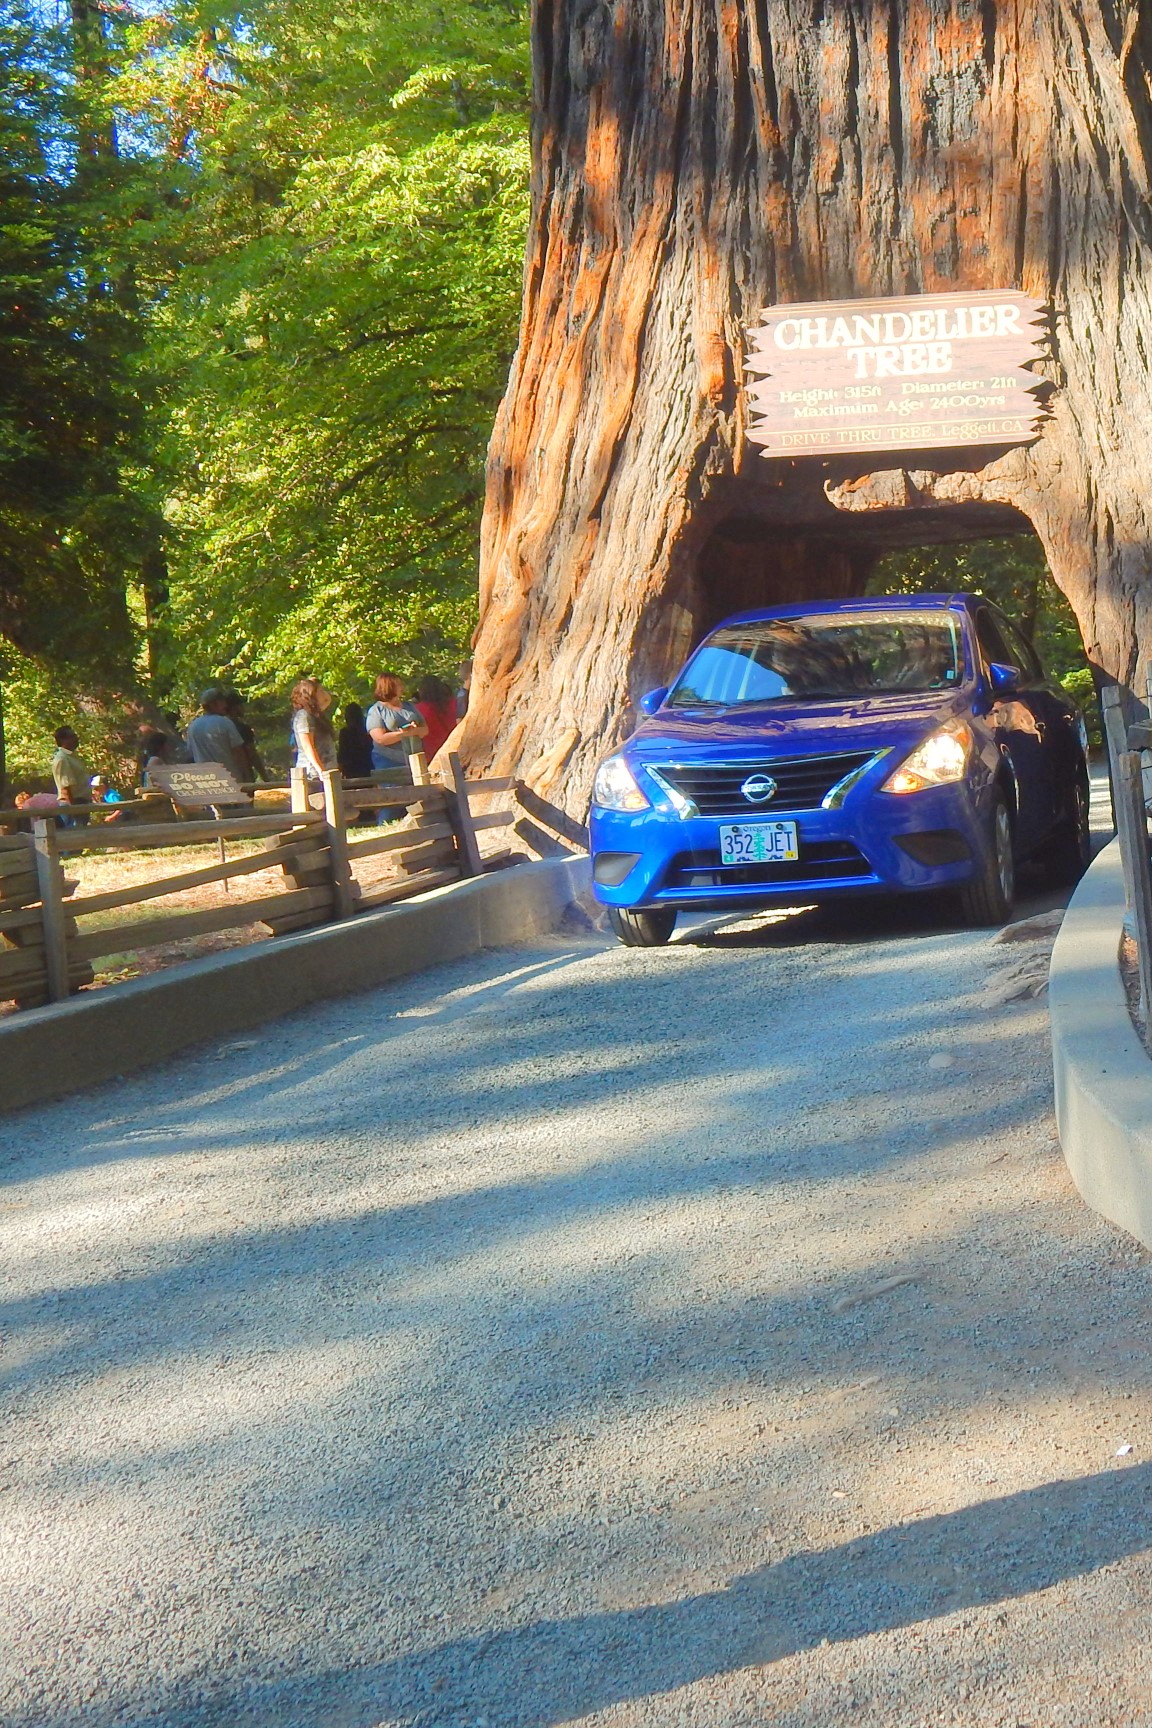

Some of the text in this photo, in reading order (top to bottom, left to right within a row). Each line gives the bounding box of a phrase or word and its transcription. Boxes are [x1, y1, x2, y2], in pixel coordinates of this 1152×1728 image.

[773, 304, 1024, 351] CHANDELIER
[846, 341, 953, 379] TREE
[779, 388, 838, 407] Height:
[901, 380, 985, 395] Diameter:
[793, 394, 1006, 419] Maximum Age: 2400yrs
[781, 432, 831, 446] DRIVE
[837, 428, 882, 442] THRU
[887, 425, 936, 440] TREE.
[1002, 420, 1024, 433] CA
[170, 772, 216, 783] Please
[195, 780, 229, 788] NOT
[743, 825, 771, 833] Oregon
[724, 831, 793, 855] 352 JET
